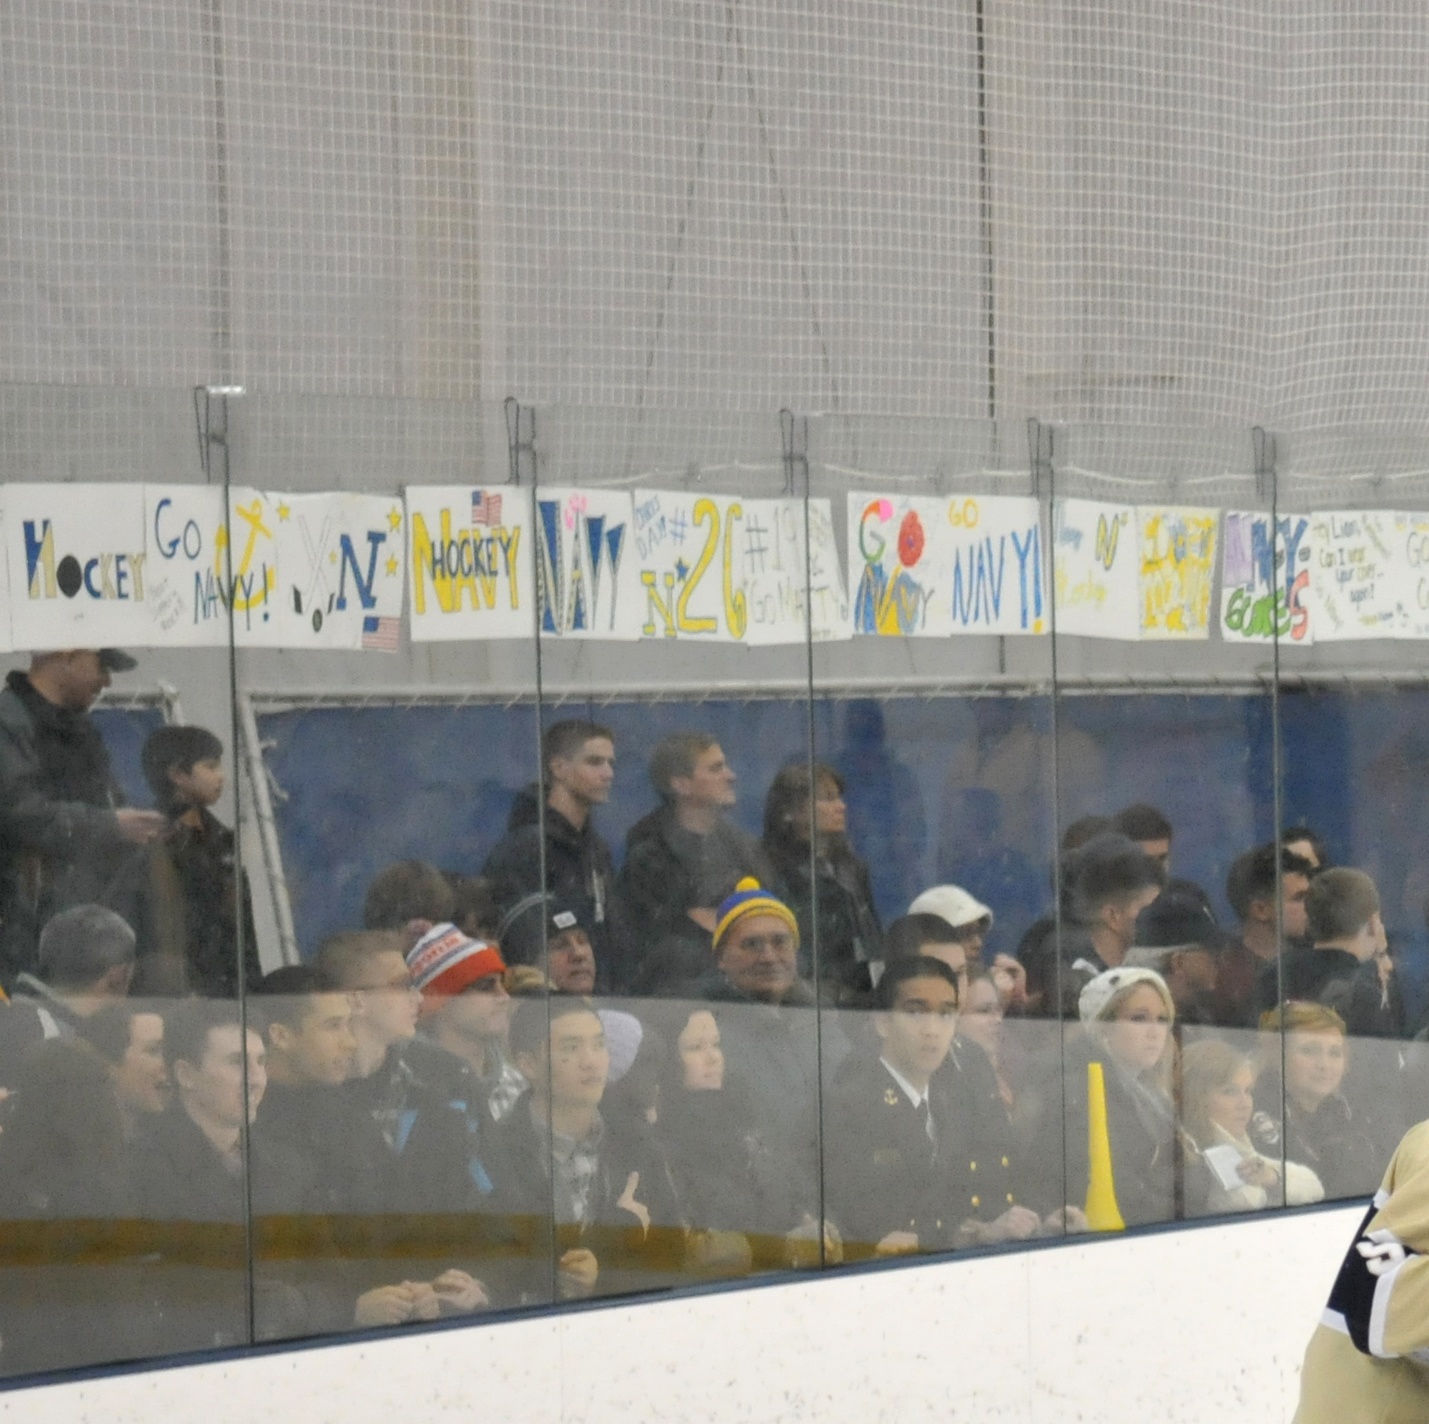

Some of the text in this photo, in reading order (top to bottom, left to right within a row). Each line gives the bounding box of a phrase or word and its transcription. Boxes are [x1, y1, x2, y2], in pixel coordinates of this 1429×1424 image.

[336, 530, 387, 610] N
[431, 533, 513, 580] HOCKEY
[193, 561, 270, 632] NAVY!
